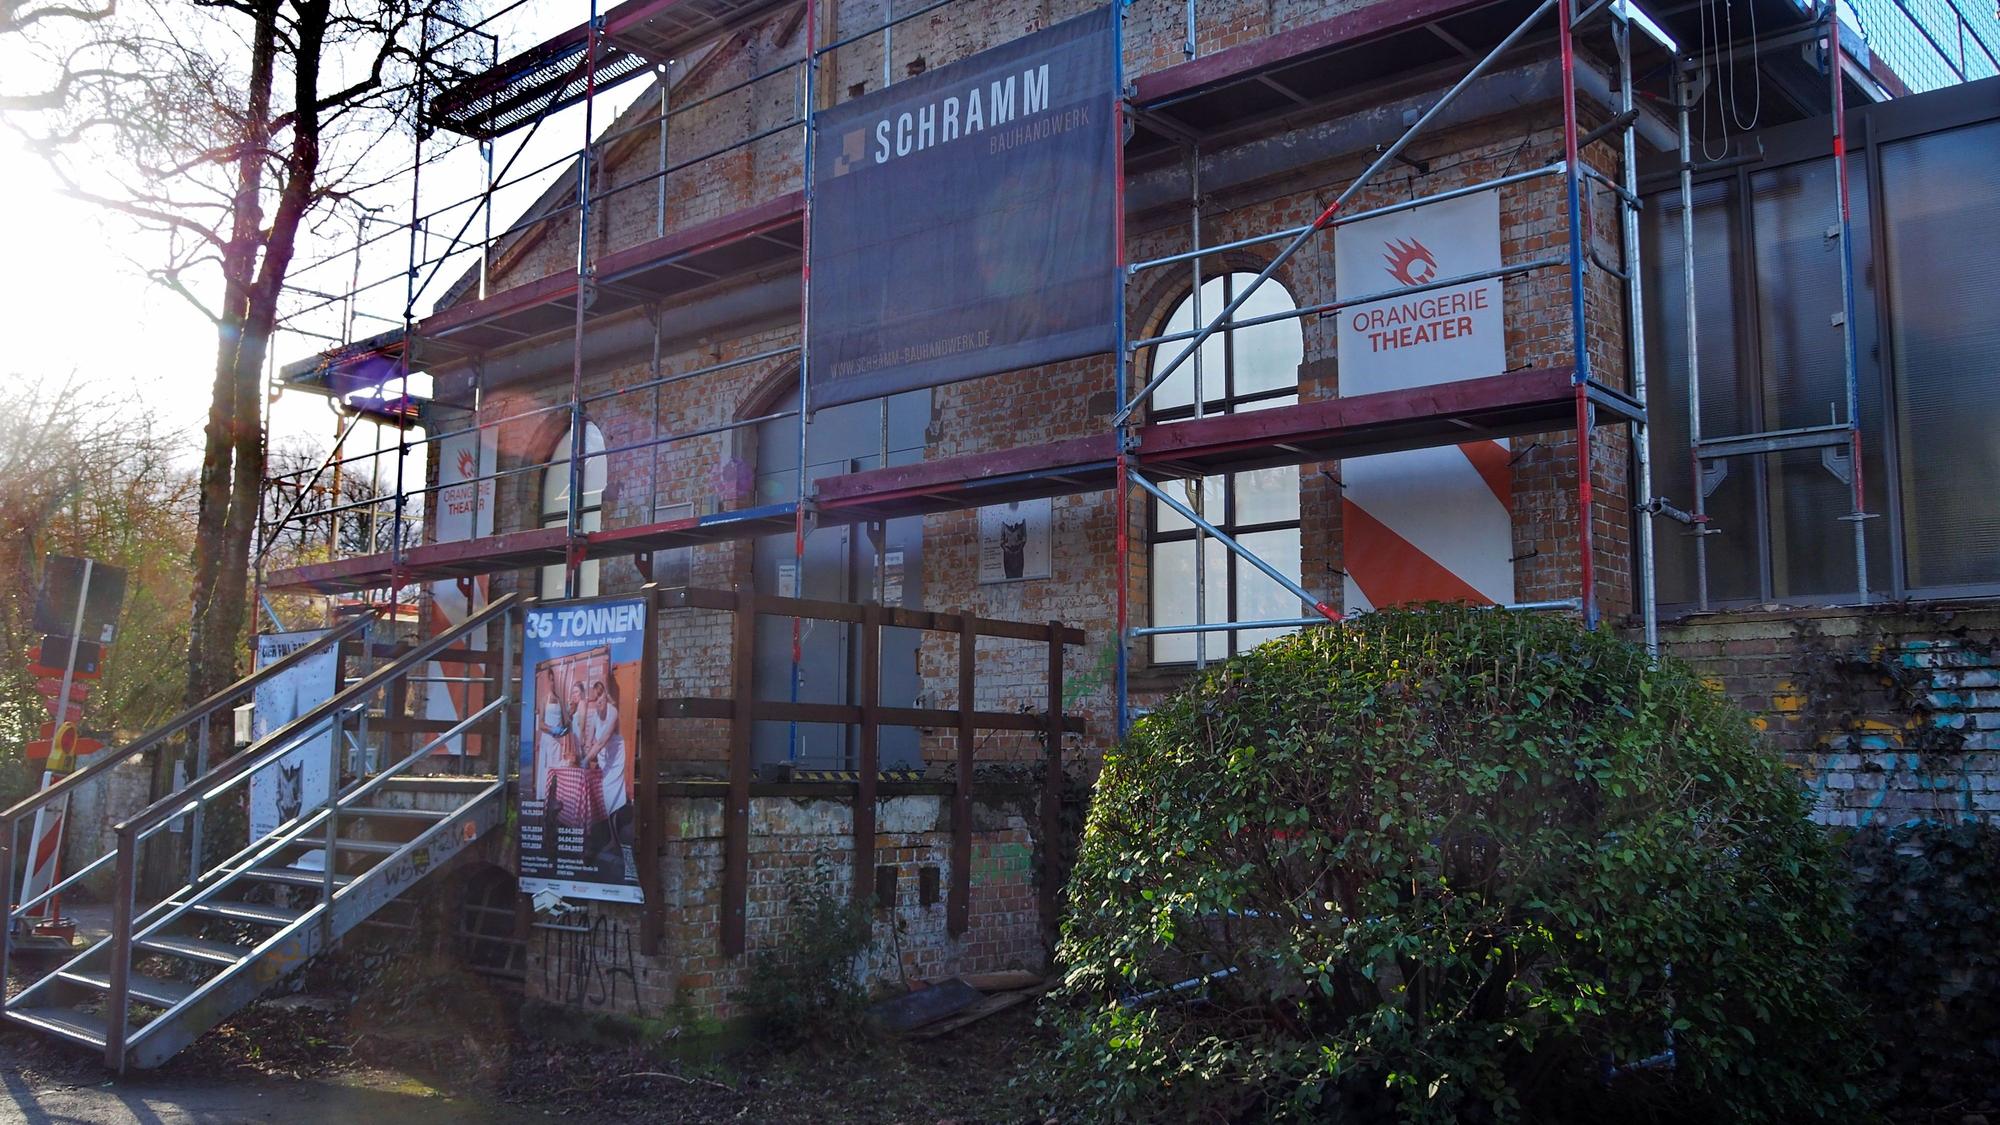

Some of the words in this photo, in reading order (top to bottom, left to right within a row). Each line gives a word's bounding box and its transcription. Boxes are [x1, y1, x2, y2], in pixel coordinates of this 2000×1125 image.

[875, 64, 1049, 164] SCHRAMM
[990, 107, 1089, 154] BAUHANDWERK
[1353, 288, 1488, 332] ORANGERIE
[830, 329, 990, 378] WWW.SCHRAMM-BAUHANDWERK.DE
[1368, 316, 1472, 352] THEATER
[443, 482, 490, 503] ORANGRIE
[448, 498, 485, 515] THEATR
[526, 612, 554, 639] 35
[557, 603, 644, 638] TONNEN
